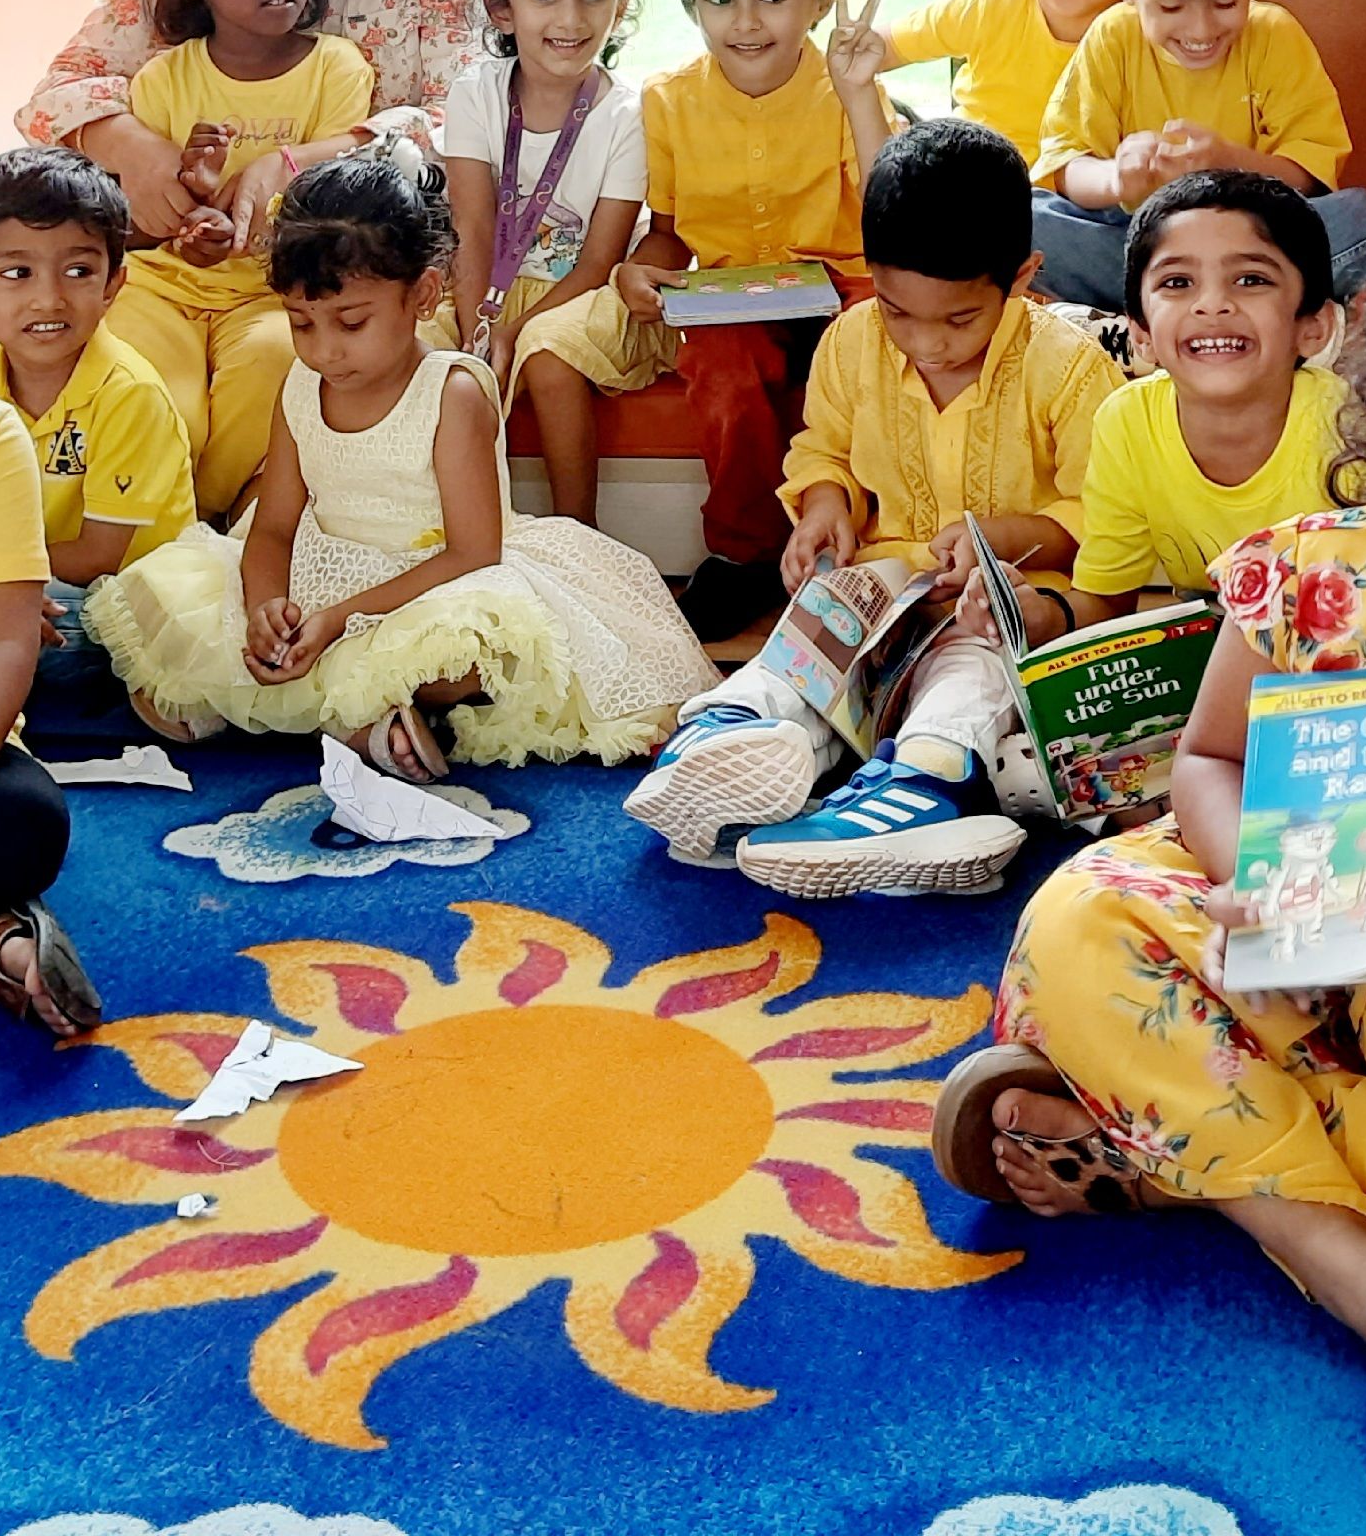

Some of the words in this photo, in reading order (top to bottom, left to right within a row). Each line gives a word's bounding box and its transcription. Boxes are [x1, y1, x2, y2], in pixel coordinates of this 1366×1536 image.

[45, 420, 87, 475] A
[1047, 660, 1066, 672] ALL
[1070, 652, 1090, 664] SET
[1094, 645, 1110, 656] TO
[1114, 637, 1146, 651] READ
[1086, 656, 1140, 682] Fun
[1064, 699, 1114, 724] the
[1122, 678, 1181, 705] Sun
[1074, 665, 1162, 704] under
[1302, 695, 1325, 709] SET
[1330, 692, 1348, 705] TO
[1290, 715, 1357, 747] The
[1289, 743, 1356, 777] and
